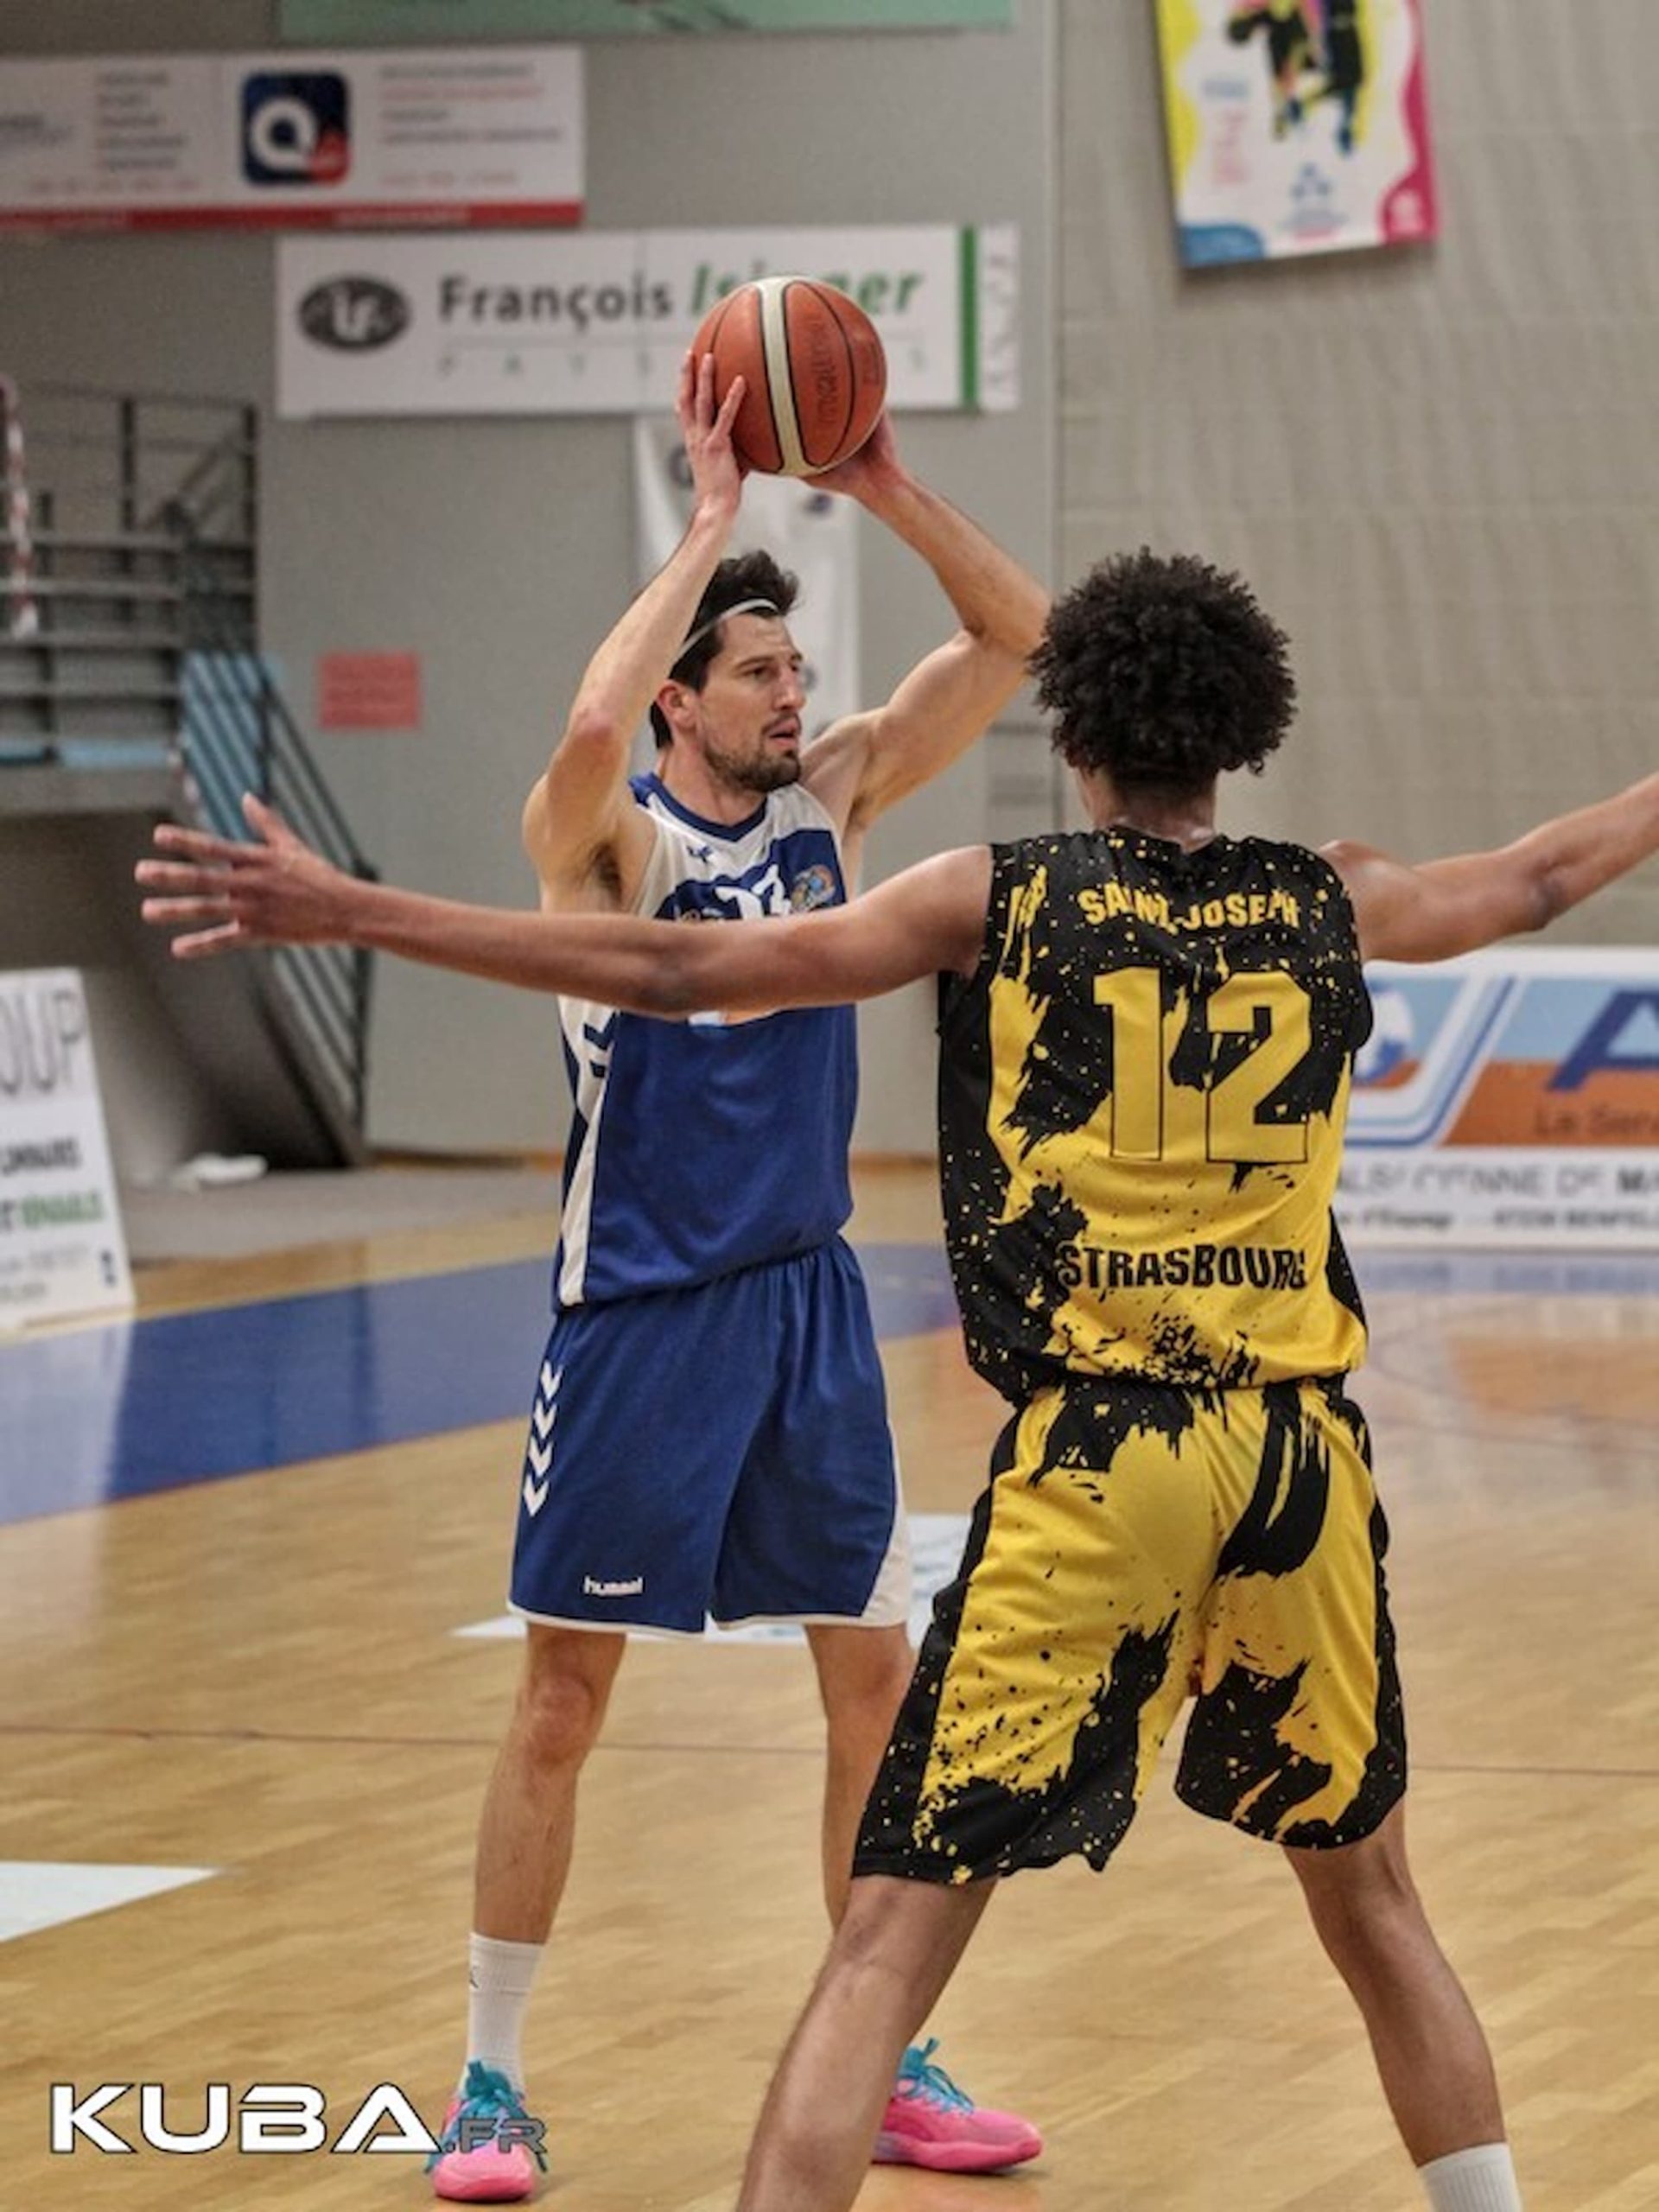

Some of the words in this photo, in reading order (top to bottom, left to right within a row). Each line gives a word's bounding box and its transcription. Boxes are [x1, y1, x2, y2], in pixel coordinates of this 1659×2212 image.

[439, 267, 673, 334] François
[1092, 965, 1312, 1164] 12
[1056, 1243, 1307, 1290] STRASBOURG
